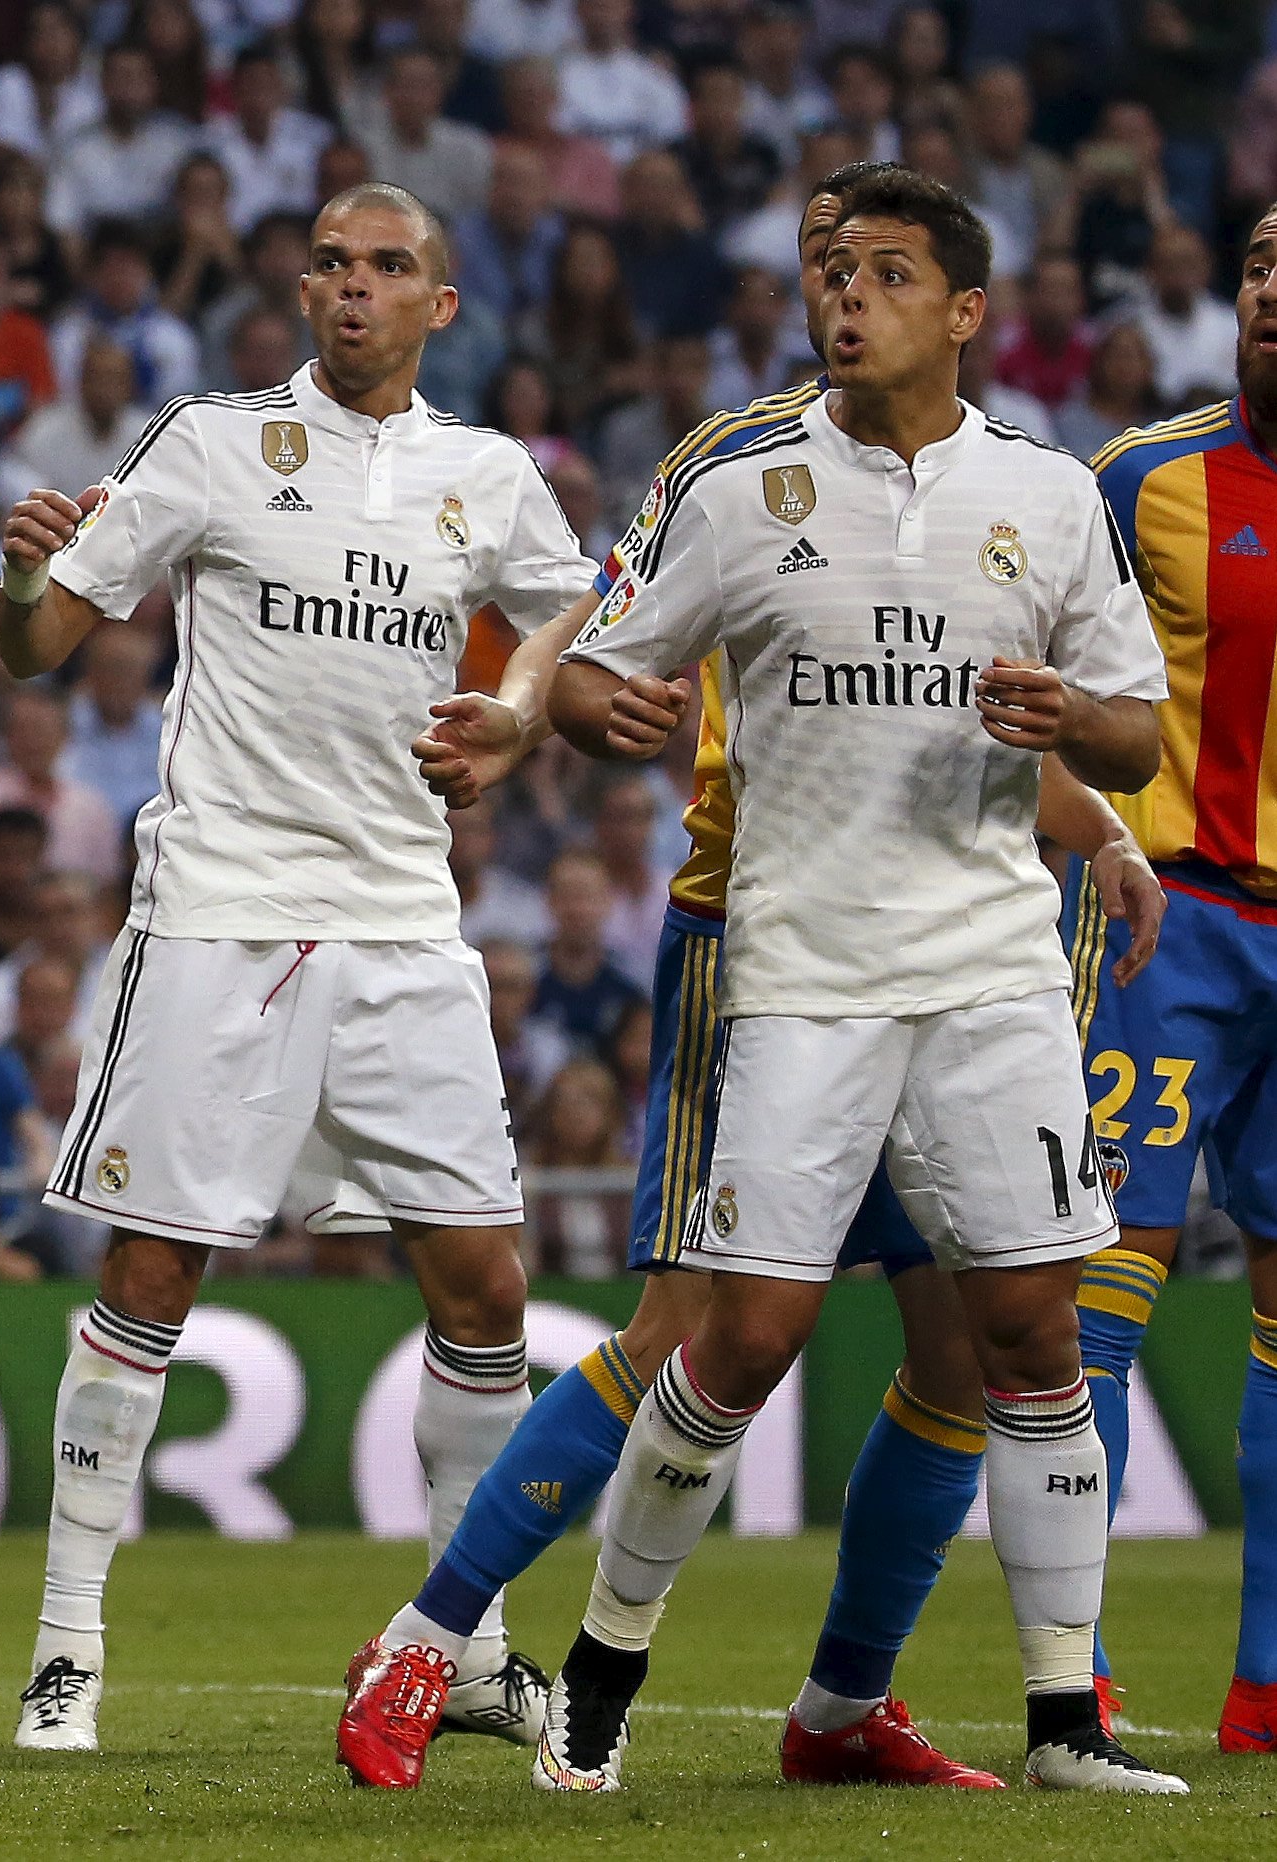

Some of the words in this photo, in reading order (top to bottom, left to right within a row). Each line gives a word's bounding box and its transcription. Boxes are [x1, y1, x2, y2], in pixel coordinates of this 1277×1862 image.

[275, 453, 298, 463] FIFA
[266, 500, 313, 512] adidas
[780, 501, 806, 512] FIFA
[345, 549, 409, 596] Fly
[776, 558, 829, 576] adidas
[873, 605, 946, 653] Fly
[787, 648, 979, 708] Emirat
[1088, 1049, 1197, 1147] 23
[60, 1440, 100, 1471] RM
[653, 1462, 712, 1490] RM
[1046, 1472, 1099, 1496] RM
